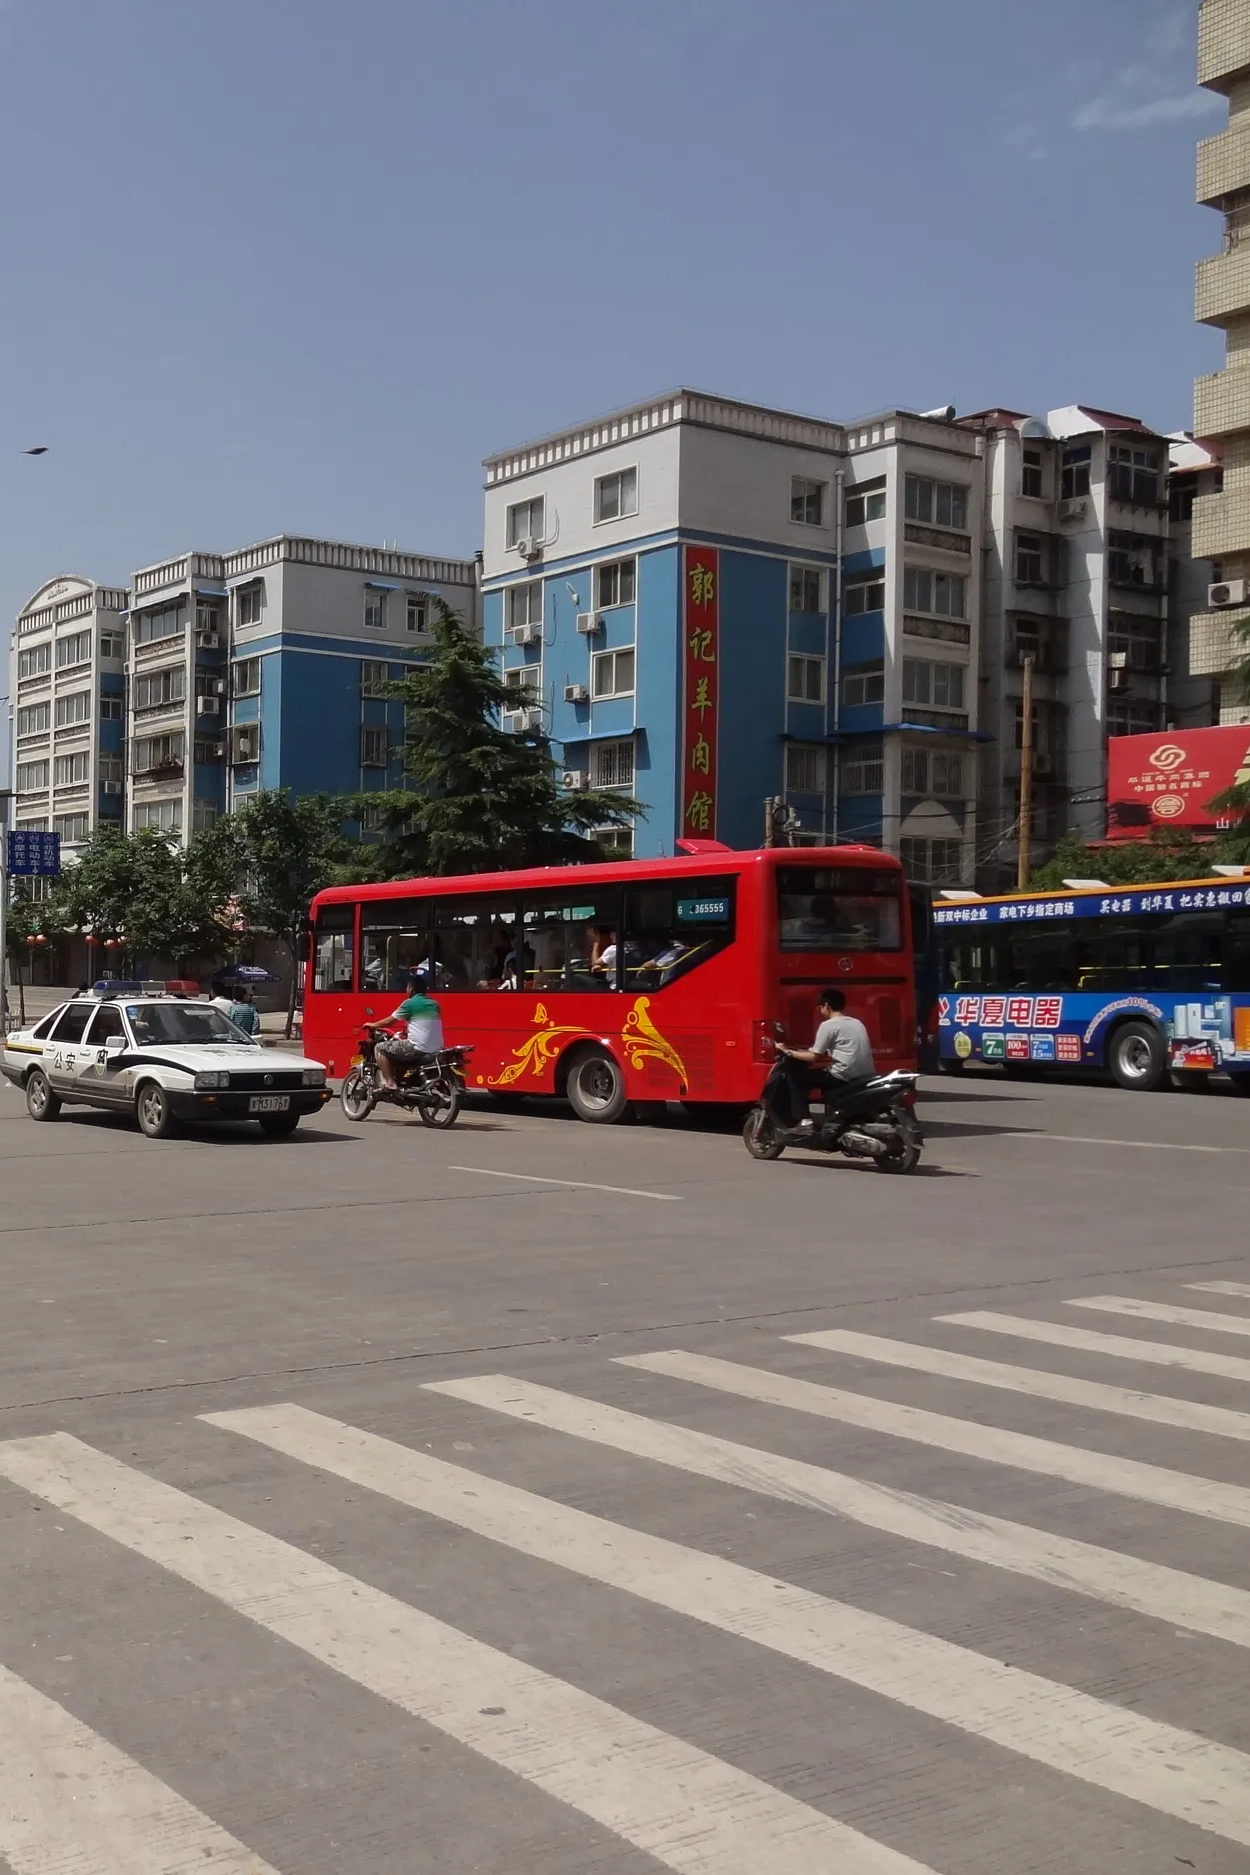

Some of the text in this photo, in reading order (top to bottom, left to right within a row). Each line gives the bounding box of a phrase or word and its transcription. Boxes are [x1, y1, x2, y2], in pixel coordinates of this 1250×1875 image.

[685, 562, 716, 832] 郭记羊肉馆
[14, 844, 26, 867] 摩托车
[29, 844, 41, 867] 电动车
[933, 901, 1074, 923] 新双中标企业 家电下乡指定商场
[954, 996, 1062, 1028] 华夏电器
[53, 1051, 77, 1072] 公安
